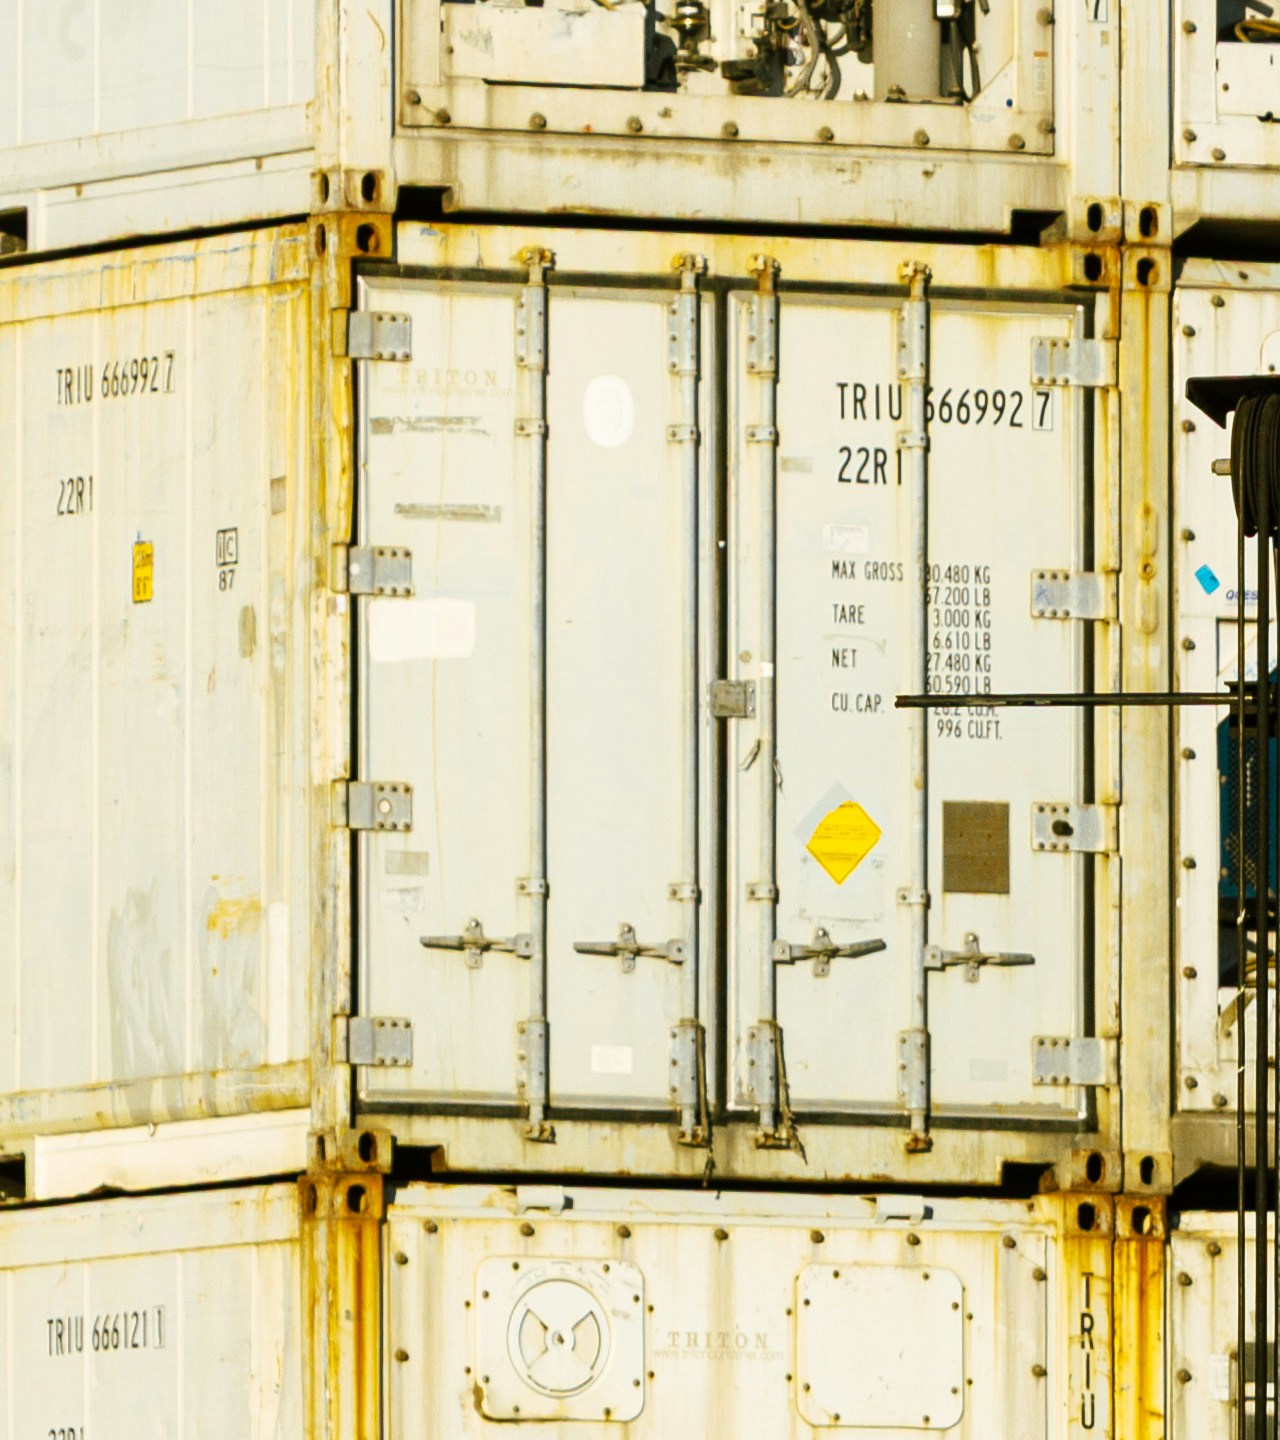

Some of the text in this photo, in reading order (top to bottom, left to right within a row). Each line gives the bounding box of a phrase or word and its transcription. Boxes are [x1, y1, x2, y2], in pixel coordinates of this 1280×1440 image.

[56, 366, 94, 405] TRIU
[101, 356, 159, 399] 666992
[836, 382, 1050, 428] TRIU 666992 7
[837, 446, 904, 485] 22R1
[57, 475, 94, 517] 22R1
[218, 570, 236, 591] 87
[832, 560, 860, 580] MAX
[865, 562, 904, 582] GROSS
[974, 566, 991, 584] KG
[974, 588, 991, 606] LB
[832, 603, 865, 625] TARE
[974, 609, 991, 628] KG
[974, 632, 991, 651] LB
[832, 649, 858, 668] NET
[974, 654, 991, 673] KG
[974, 676, 991, 694] LB
[936, 719, 963, 738] 996
[47, 1316, 84, 1356] TRIU
[92, 1310, 148, 1352] 666121
[1081, 1271, 1095, 1429] TRIU
